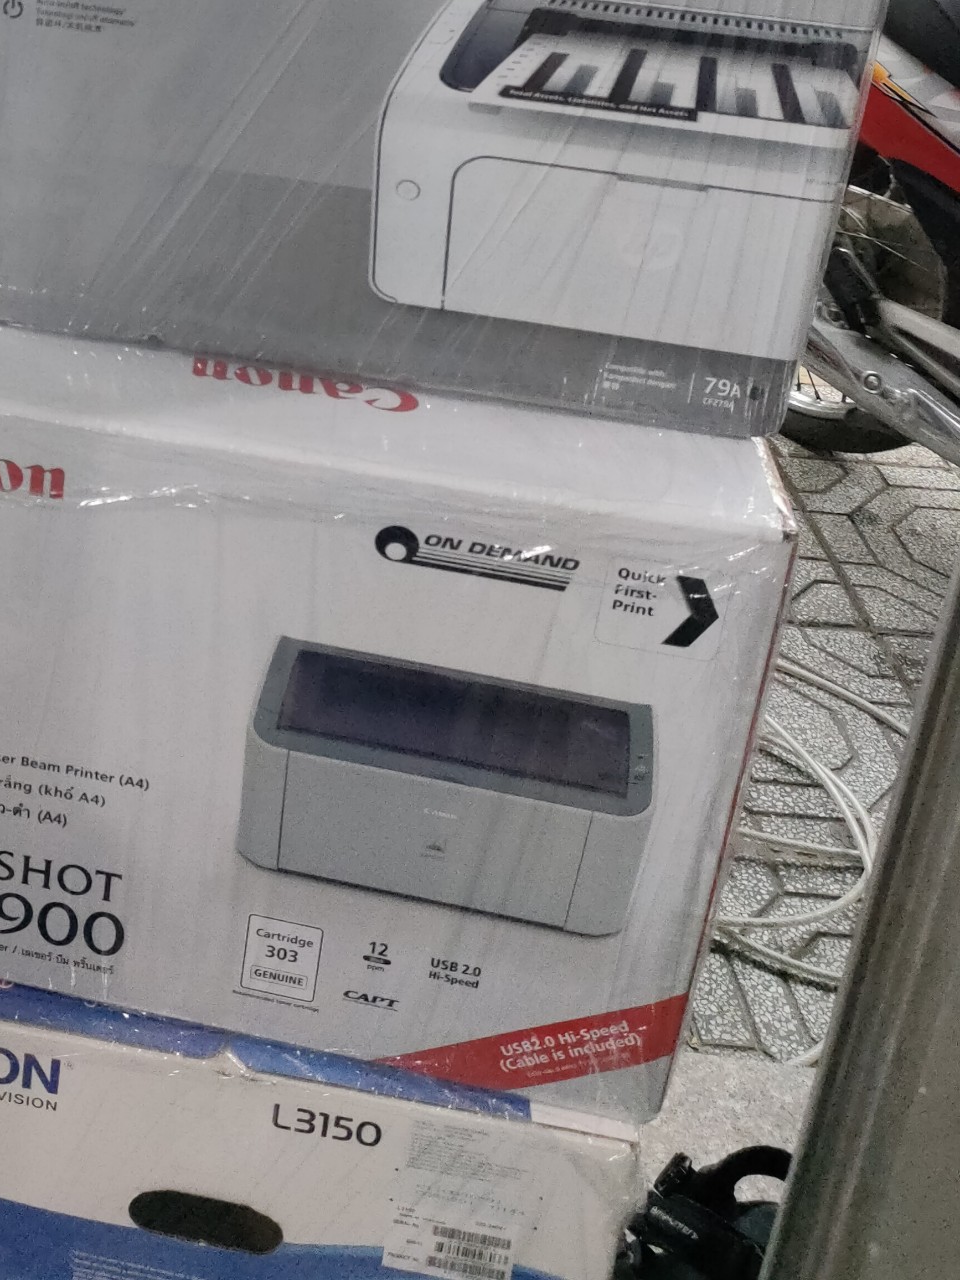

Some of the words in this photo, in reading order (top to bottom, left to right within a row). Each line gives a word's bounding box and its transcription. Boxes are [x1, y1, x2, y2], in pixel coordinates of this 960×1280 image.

[192, 357, 419, 412] Canon
[704, 377, 741, 398] 79A
[424, 534, 462, 551] ON
[468, 539, 581, 571] DEMAND
[618, 568, 667, 585] Quick
[612, 600, 655, 618] Print
[21, 756, 61, 773] Beam
[65, 765, 115, 783] Printer
[119, 774, 150, 791] (A4)
[77, 792, 106, 808] A4)
[37, 809, 68, 828] (A4)
[255, 928, 314, 949] Cartridge
[264, 945, 299, 963] 303
[369, 941, 389, 958] 12
[253, 967, 304, 987] GENUINE
[430, 957, 459, 973] USB
[462, 964, 482, 978] 2.0
[428, 970, 480, 989] Hi-Speed
[343, 990, 400, 1008] CAPT
[500, 1035, 556, 1057] USB2.0
[558, 1019, 630, 1047] Hi-Speed
[499, 1053, 550, 1073] (Cable
[551, 1048, 566, 1062] is
[568, 1032, 642, 1058] included)
[272, 1103, 382, 1147] L3150
